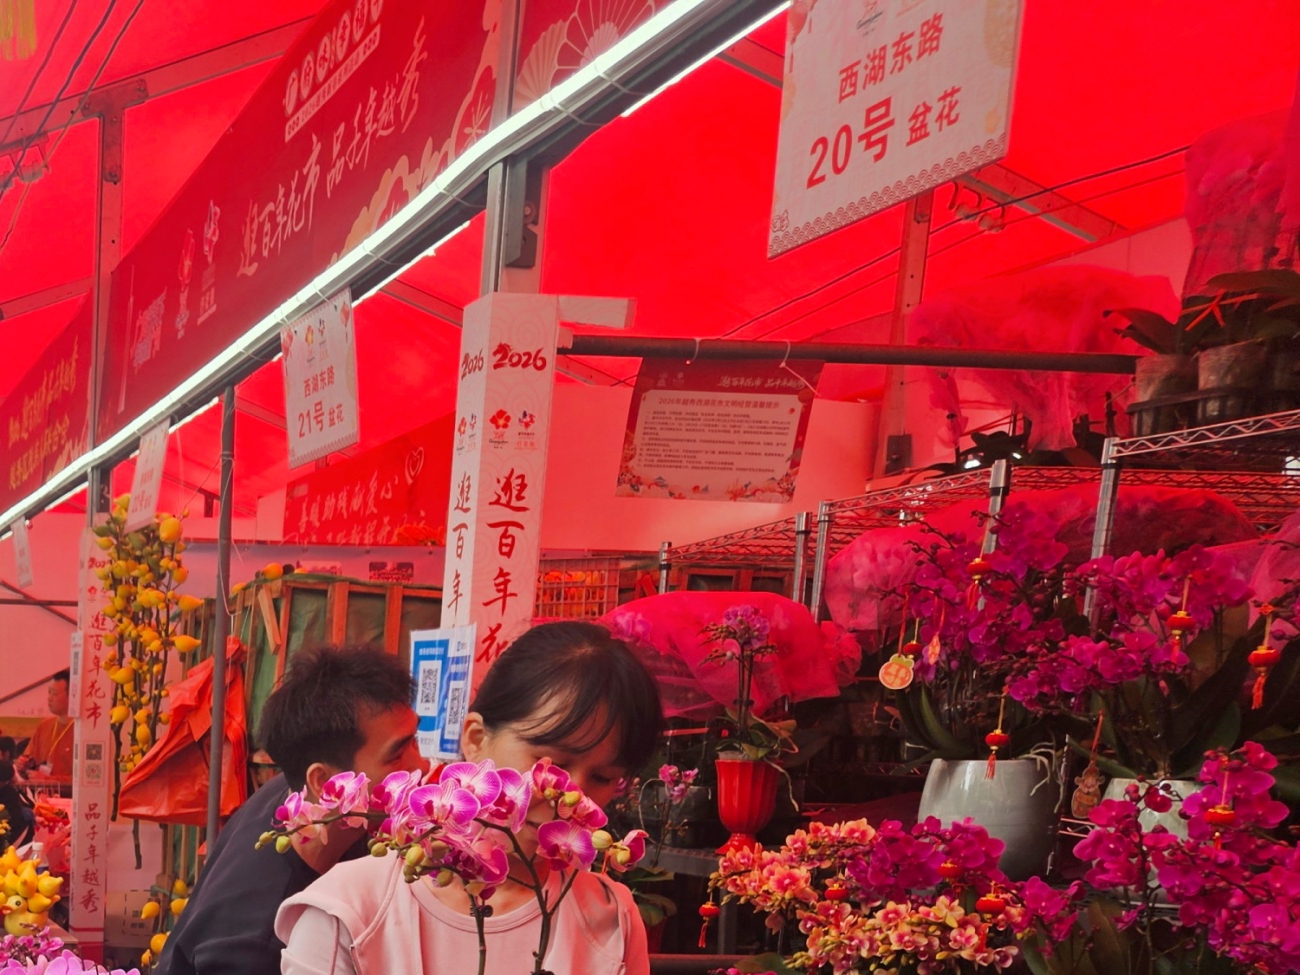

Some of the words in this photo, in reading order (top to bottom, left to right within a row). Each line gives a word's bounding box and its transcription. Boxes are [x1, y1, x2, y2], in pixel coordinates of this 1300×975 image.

[838, 12, 944, 104] 西湖东路
[807, 97, 895, 190] 20号
[906, 86, 962, 147] 盆花
[236, 131, 322, 279] 逛百年花市
[303, 365, 335, 398] 西湖东路
[462, 349, 484, 380] 2026
[492, 342, 547, 371] 2026
[298, 400, 325, 438] 21号
[328, 403, 344, 428] 盆花
[447, 471, 471, 628] 逛百年
[475, 468, 530, 665] 逛百年花
[85, 611, 107, 730] 逛百年花市
[81, 803, 101, 913] 品千年越秀
